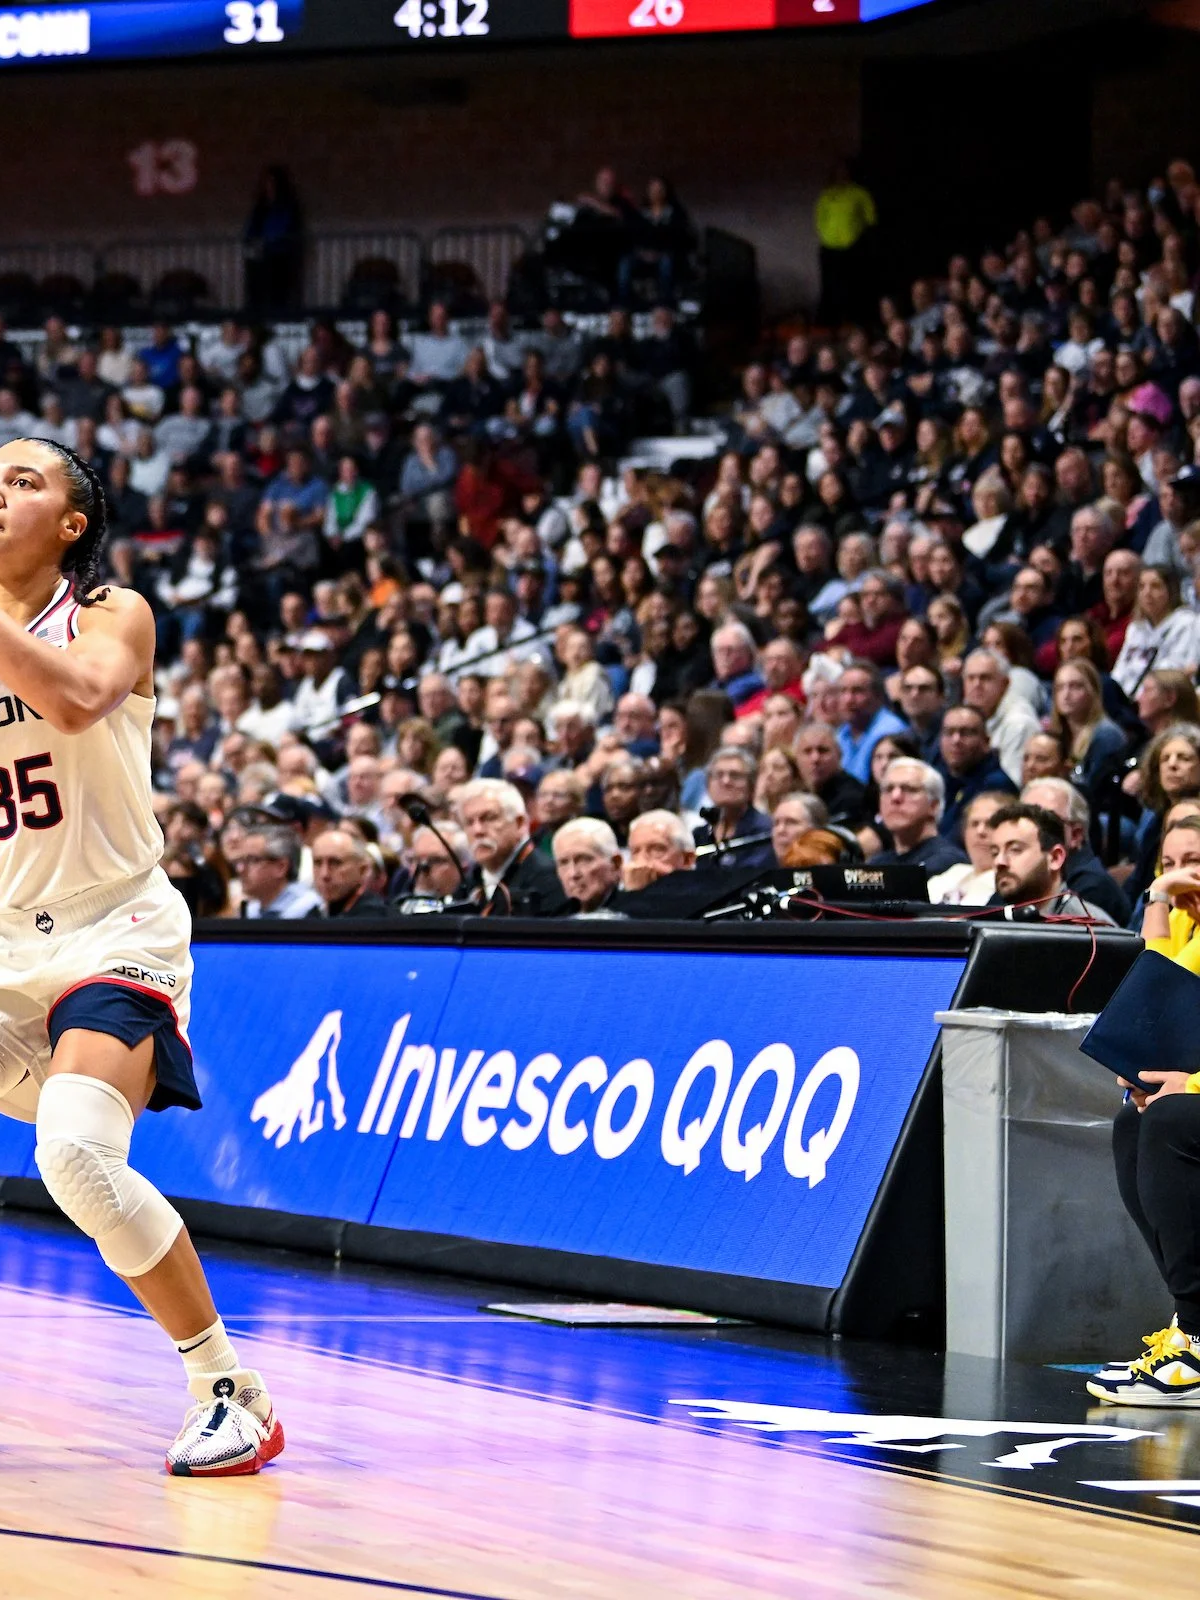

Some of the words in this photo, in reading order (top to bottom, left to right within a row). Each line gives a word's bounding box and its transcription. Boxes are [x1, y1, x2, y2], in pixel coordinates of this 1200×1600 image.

[224, 1, 284, 44] 31
[394, 0, 489, 38] 4:12
[129, 141, 196, 193] 13
[112, 965, 176, 988] USKIES
[357, 1012, 655, 1161] Invesco
[660, 1039, 861, 1189] QQQ
